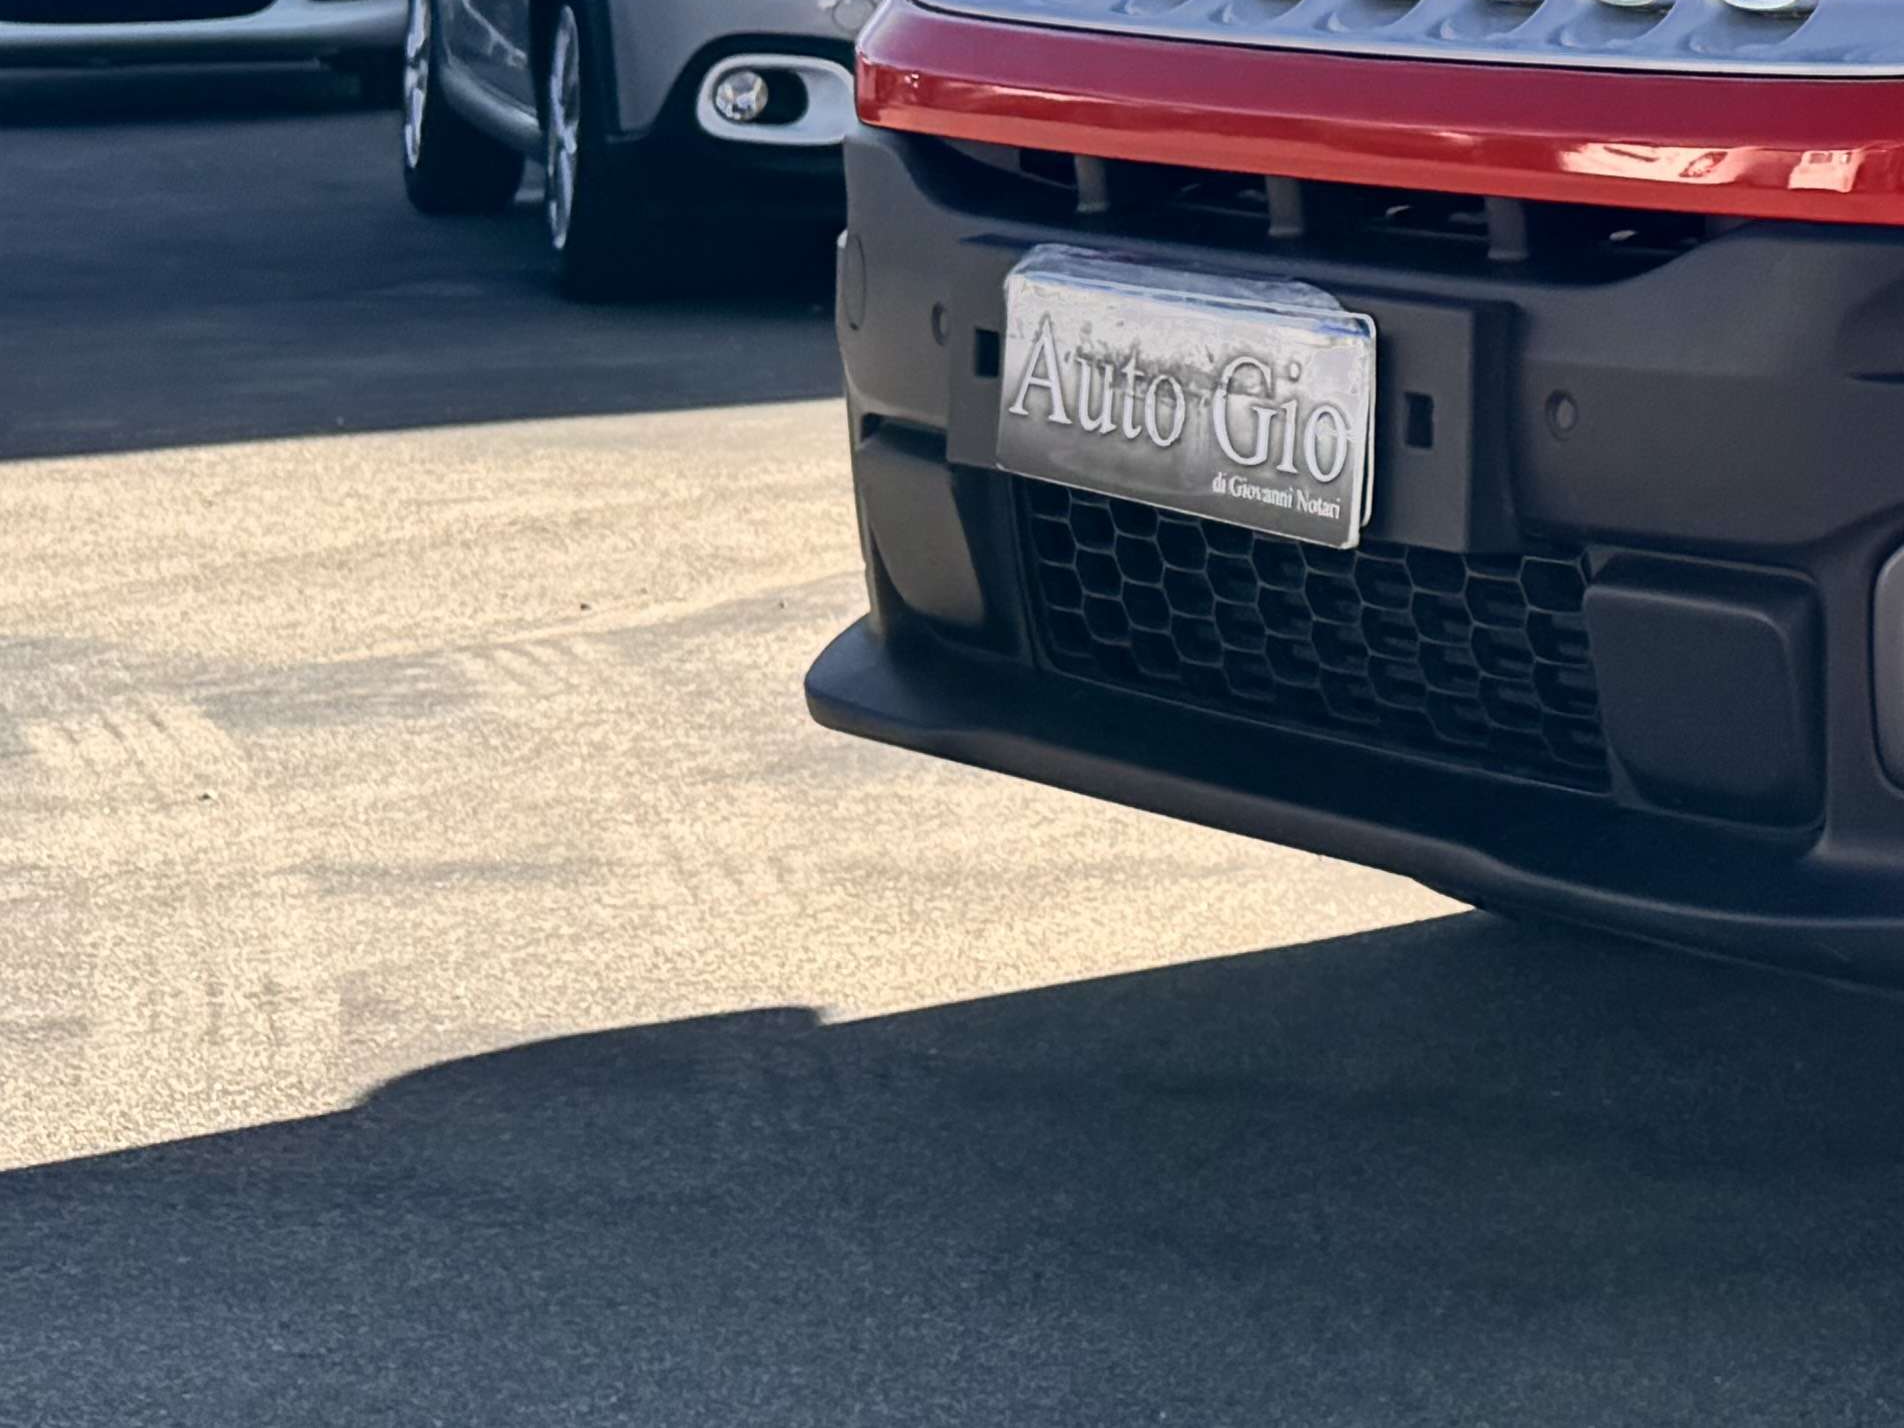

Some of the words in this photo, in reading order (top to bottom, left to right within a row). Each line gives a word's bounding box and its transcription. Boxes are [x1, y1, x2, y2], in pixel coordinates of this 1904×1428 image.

[1009, 312, 1186, 447] Auto
[1212, 357, 1352, 482] Gio
[1229, 475, 1293, 508] Giovanni
[1297, 489, 1341, 519] Notari
